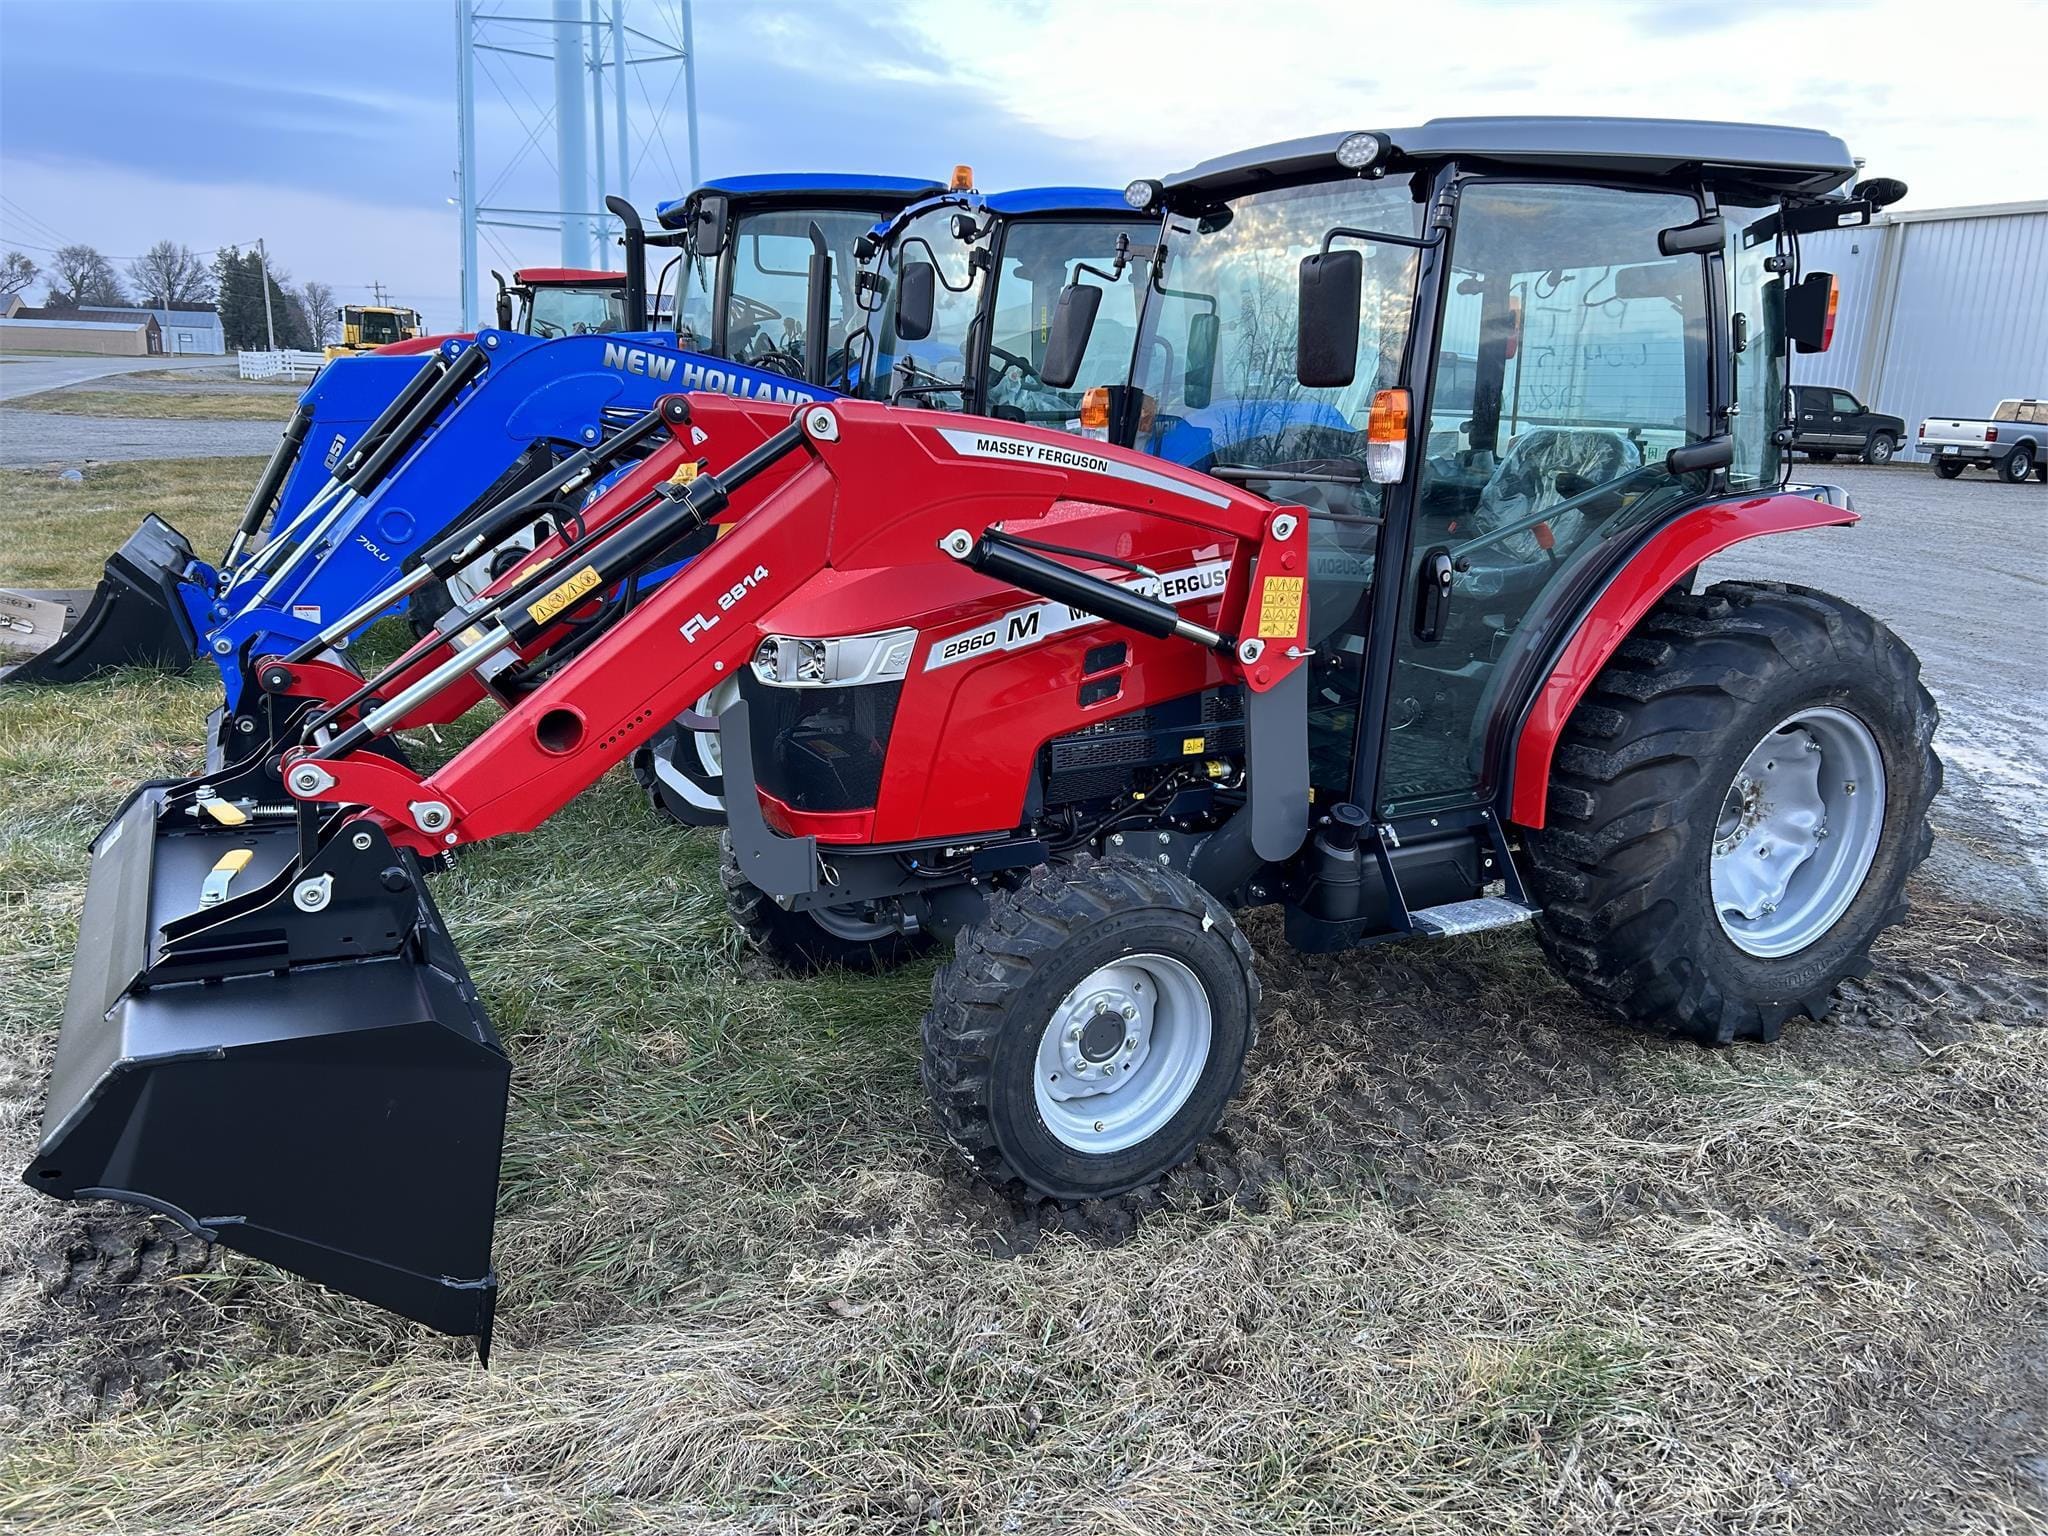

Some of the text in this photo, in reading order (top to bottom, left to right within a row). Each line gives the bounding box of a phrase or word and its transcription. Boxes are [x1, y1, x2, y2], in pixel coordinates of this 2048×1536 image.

[603, 342, 814, 404] NEW HOLLAND
[977, 439, 1108, 473] MASSEY FERGUSON
[356, 534, 390, 562] 710LU
[679, 564, 769, 643] FL 2814
[943, 631, 997, 659] 2860
[1007, 611, 1040, 642] M
